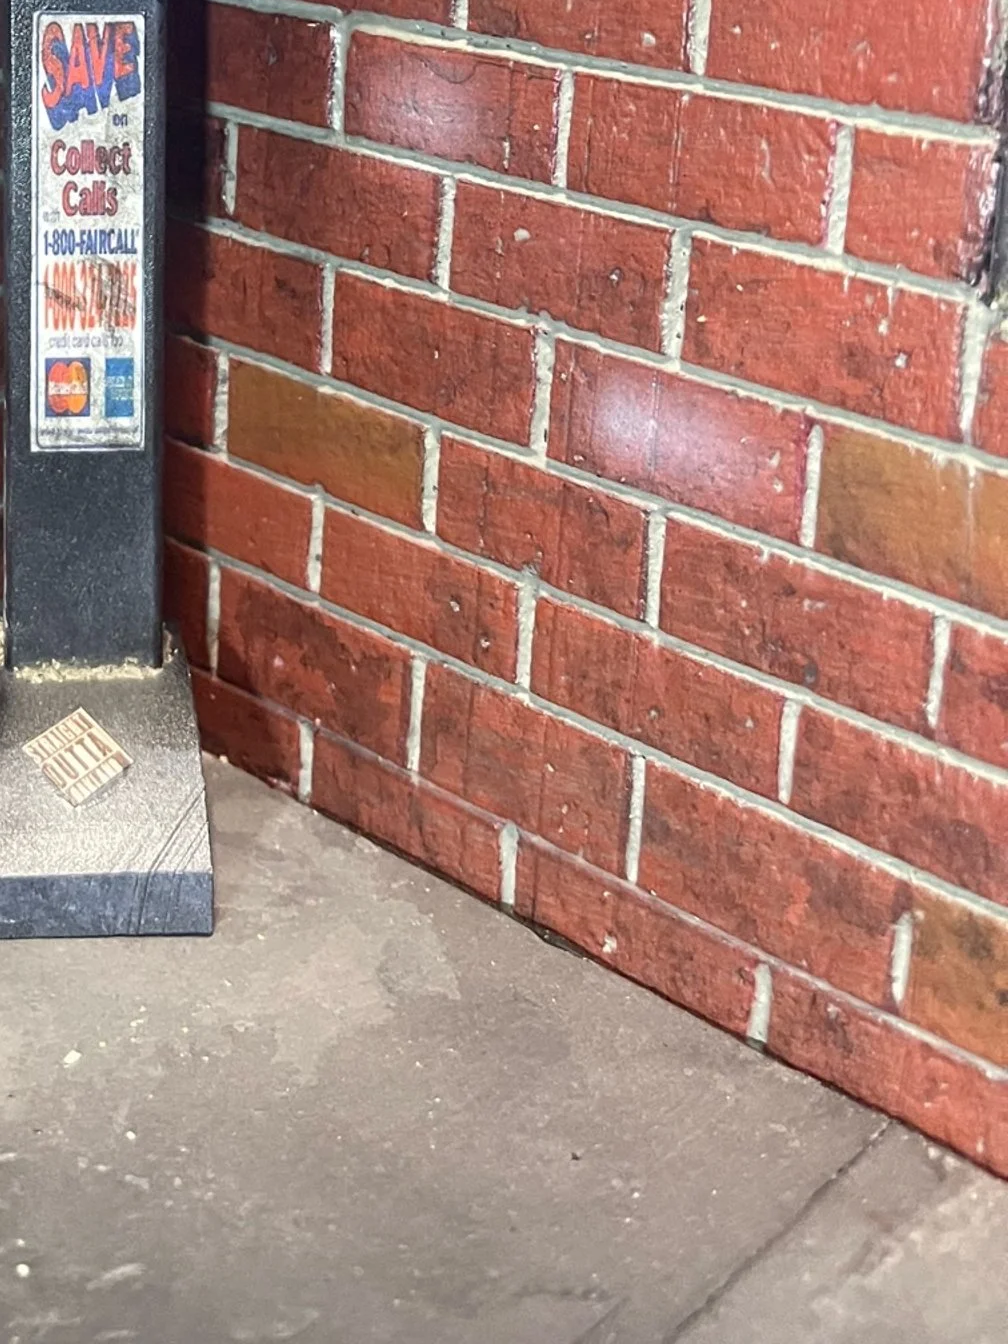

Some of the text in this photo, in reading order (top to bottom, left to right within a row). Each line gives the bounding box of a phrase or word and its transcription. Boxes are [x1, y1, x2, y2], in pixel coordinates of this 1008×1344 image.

[41, 20, 141, 126] SAVE
[112, 114, 128, 127] on
[50, 139, 132, 176] Collect
[62, 181, 119, 217] Calls
[23, 712, 90, 764] STRAIGHT
[39, 729, 112, 790] OUTTA
